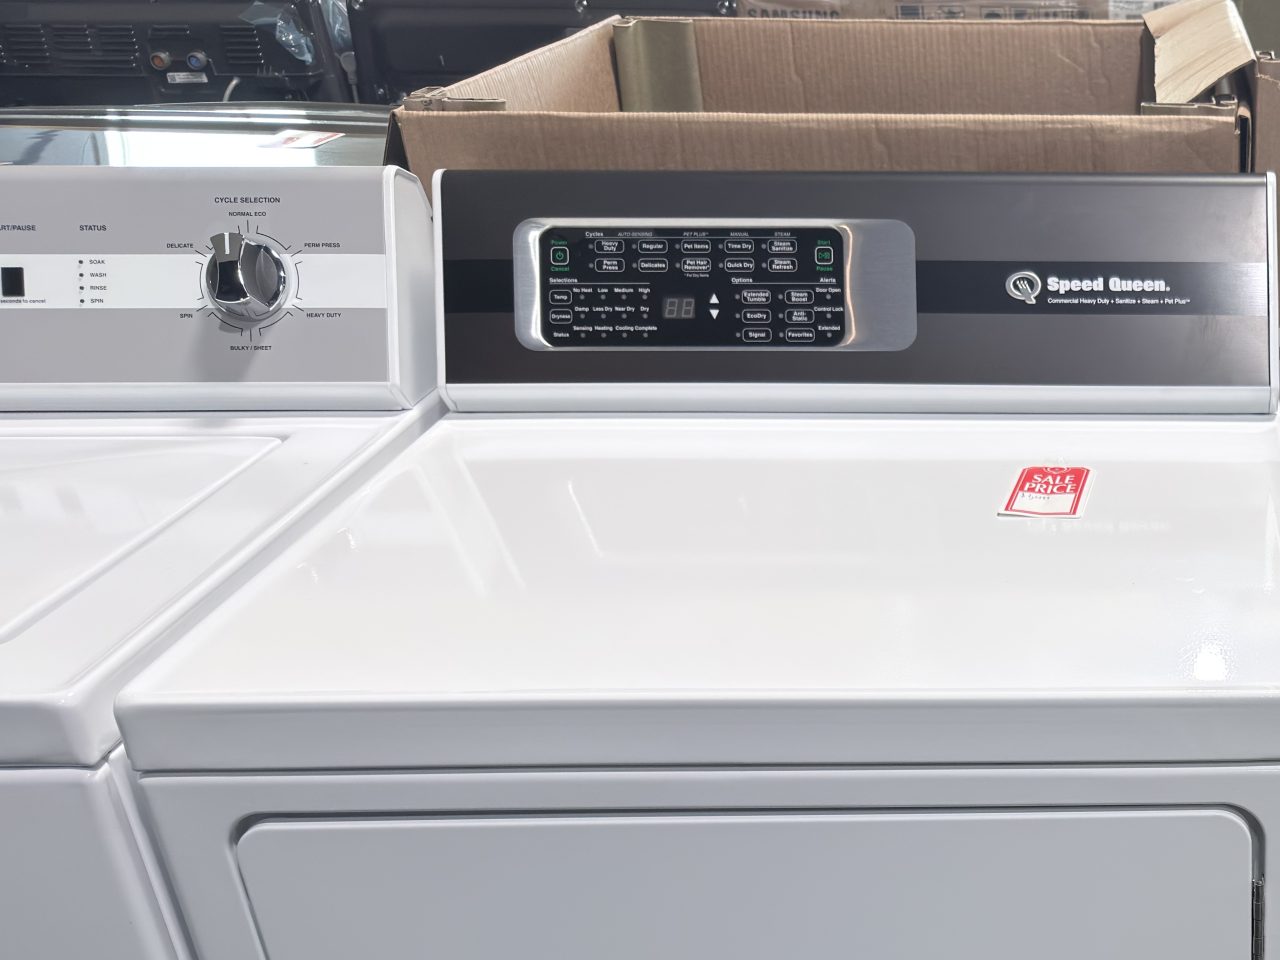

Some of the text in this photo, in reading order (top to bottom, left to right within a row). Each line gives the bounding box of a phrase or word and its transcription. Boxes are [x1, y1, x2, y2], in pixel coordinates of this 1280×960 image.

[1047, 277, 1104, 295] Speed
[1032, 474, 1075, 484] SALE
[1024, 482, 1077, 494] PRICE
